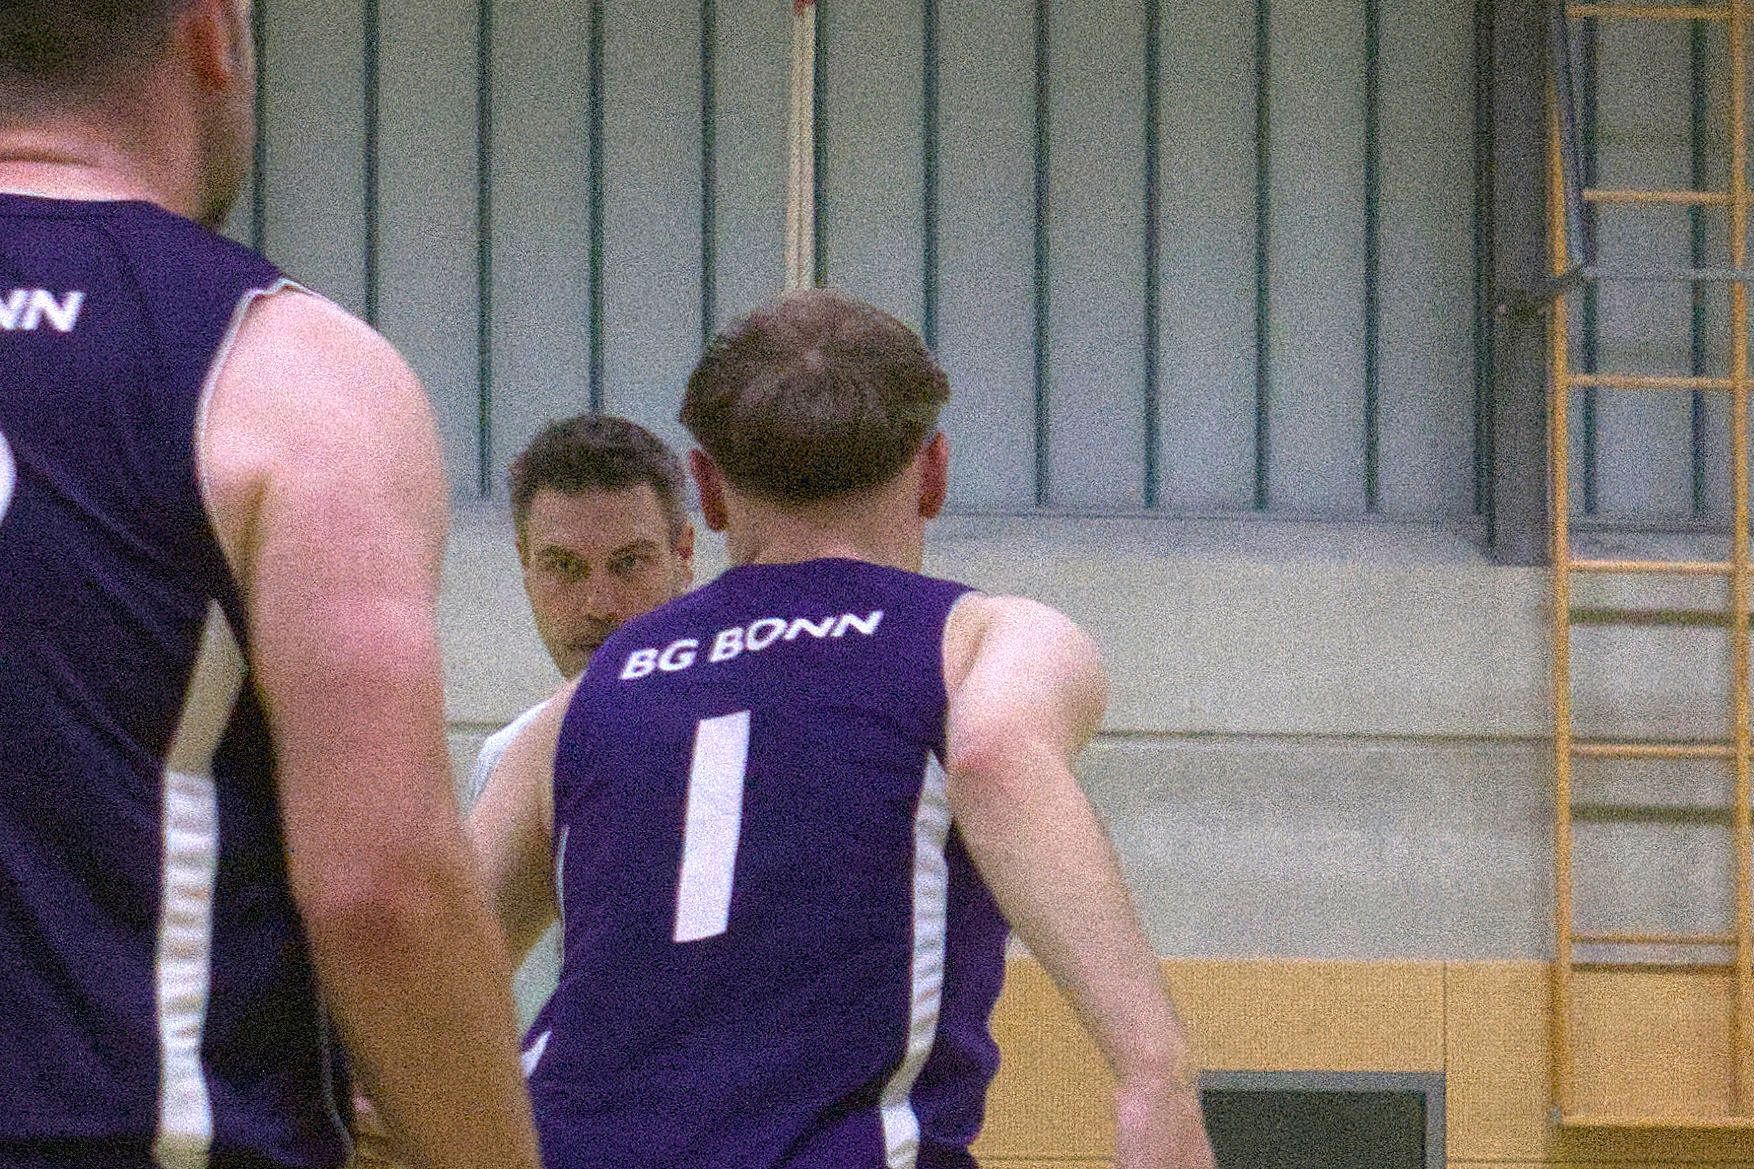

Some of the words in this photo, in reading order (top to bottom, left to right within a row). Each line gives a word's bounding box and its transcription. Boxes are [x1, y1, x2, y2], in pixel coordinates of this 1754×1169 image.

[620, 639, 699, 680] BG
[709, 611, 884, 662] BONN
[673, 709, 751, 943] 1
